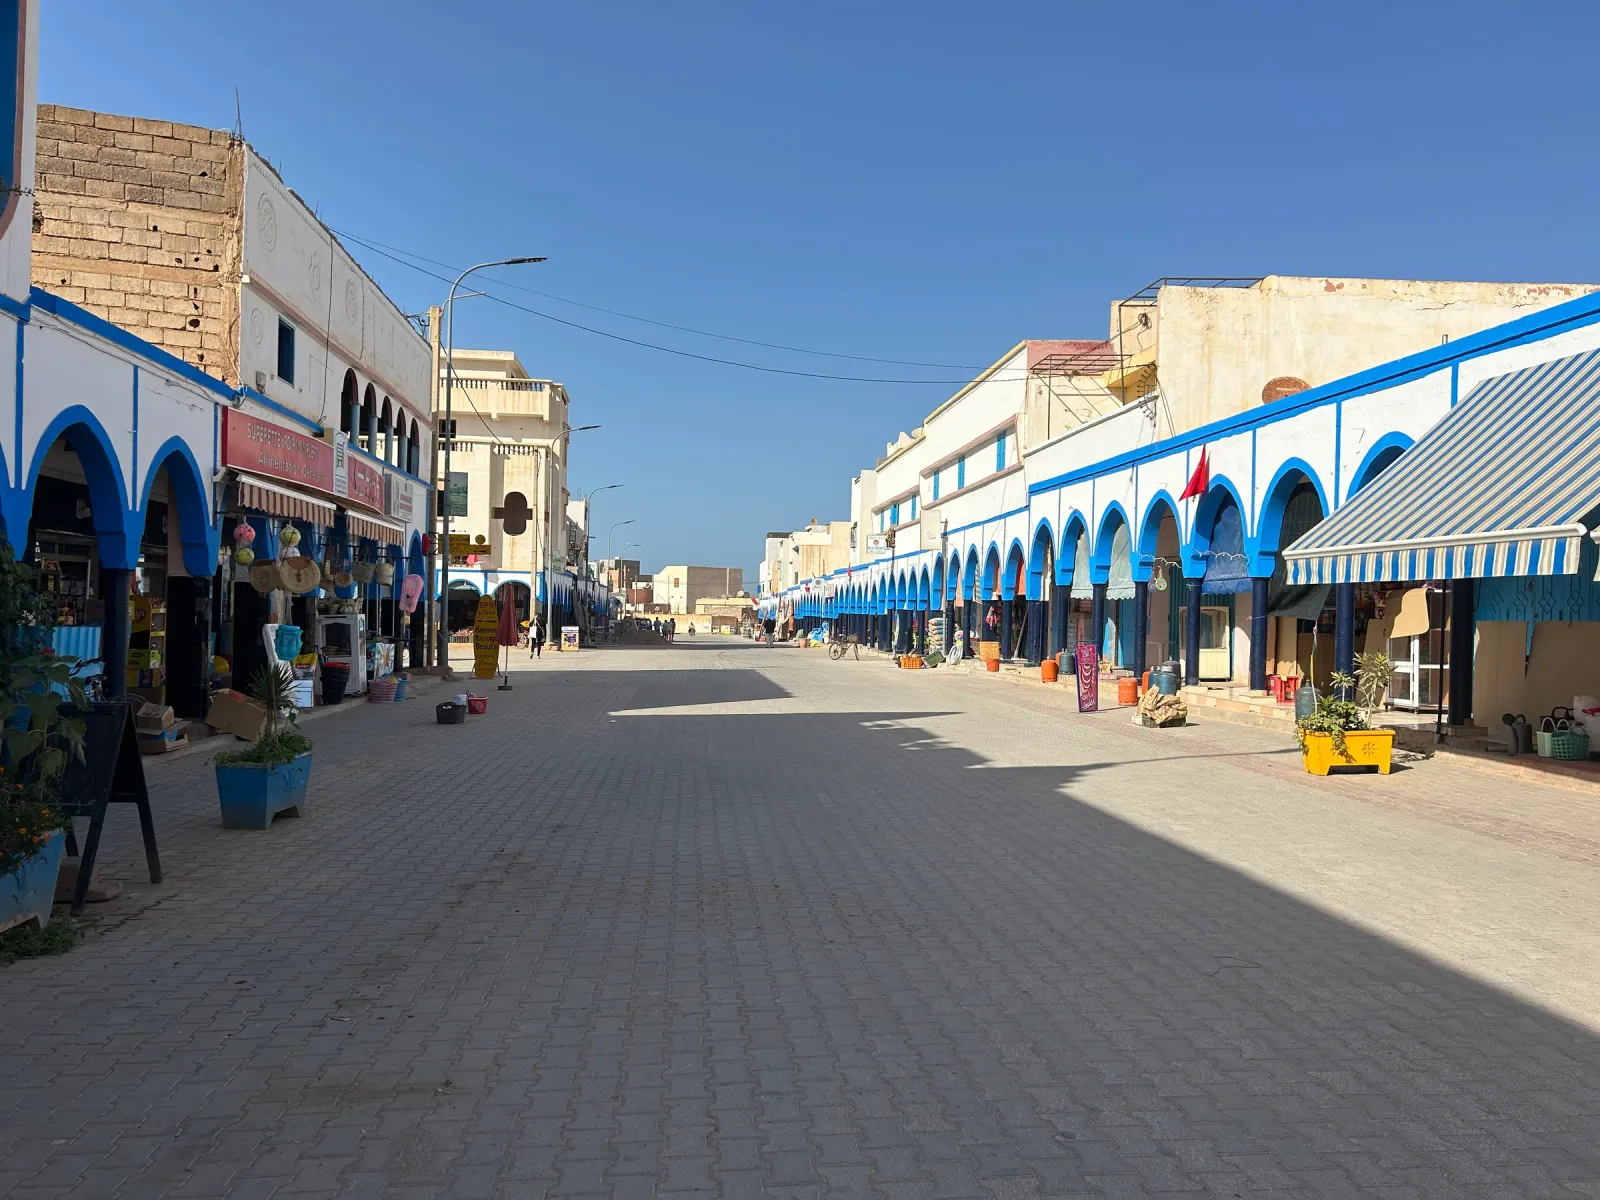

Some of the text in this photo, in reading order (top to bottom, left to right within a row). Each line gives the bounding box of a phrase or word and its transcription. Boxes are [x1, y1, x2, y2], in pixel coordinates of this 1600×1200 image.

[247, 422, 282, 449] SUPERETTE
[258, 451, 300, 476] Alimentation
[479, 601, 494, 609] SPA
